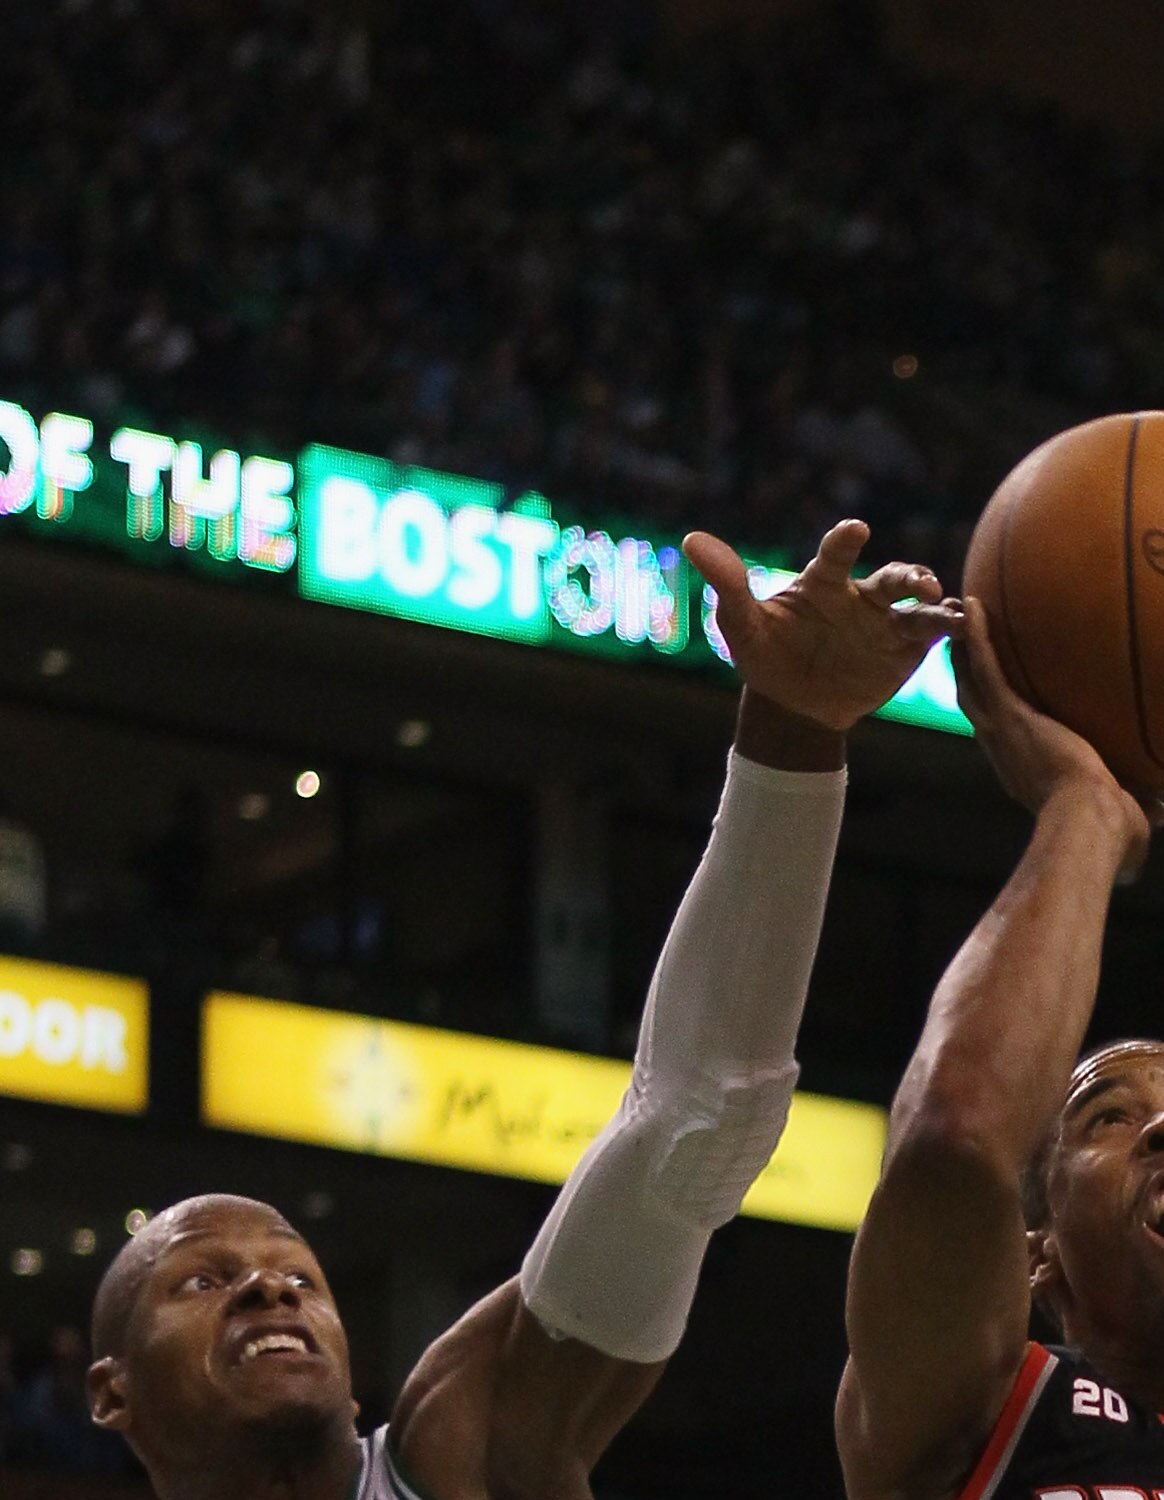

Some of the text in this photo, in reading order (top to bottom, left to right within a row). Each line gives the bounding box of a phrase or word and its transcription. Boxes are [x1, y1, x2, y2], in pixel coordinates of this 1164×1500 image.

[110, 427, 298, 573] THE
[317, 475, 690, 654] BOSTON
[1072, 1378, 1129, 1422] 20
